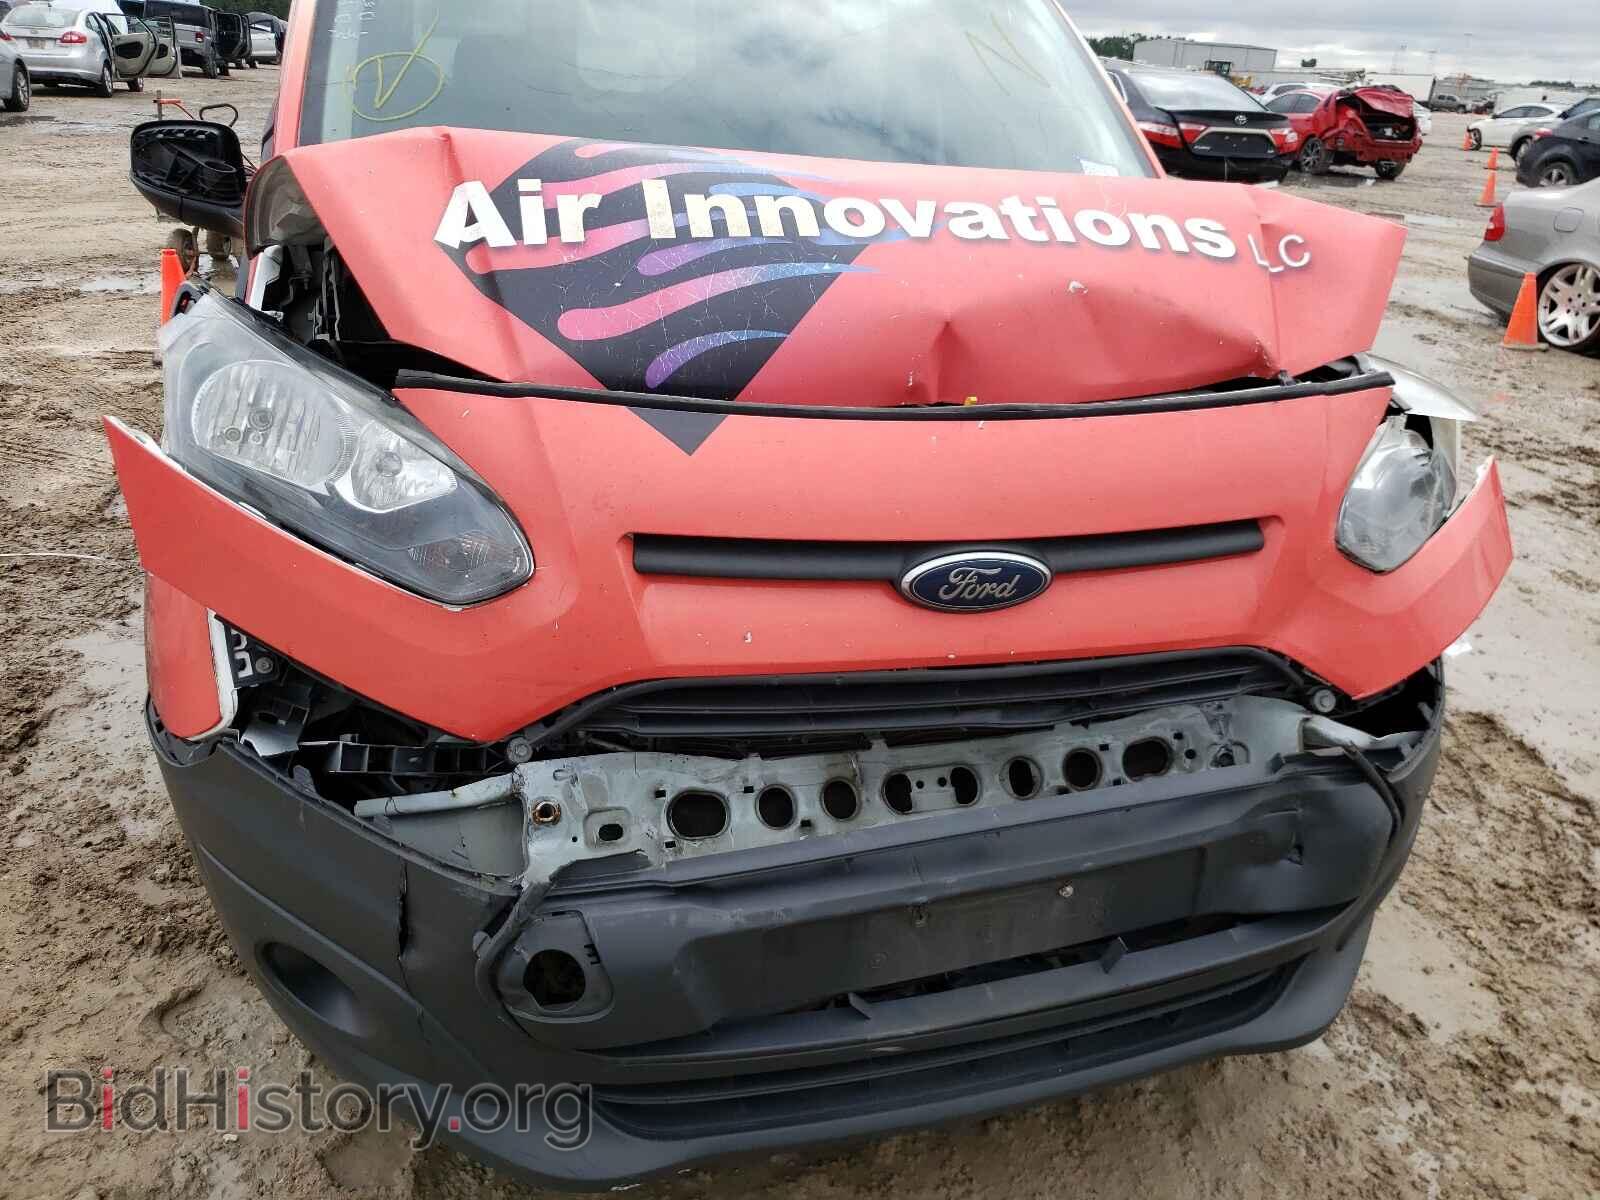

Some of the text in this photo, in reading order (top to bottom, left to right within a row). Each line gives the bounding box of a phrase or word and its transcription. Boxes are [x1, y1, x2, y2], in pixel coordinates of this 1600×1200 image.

[433, 178, 602, 248] Air
[641, 178, 1236, 259] Innovations
[938, 567, 1021, 600] Ford
